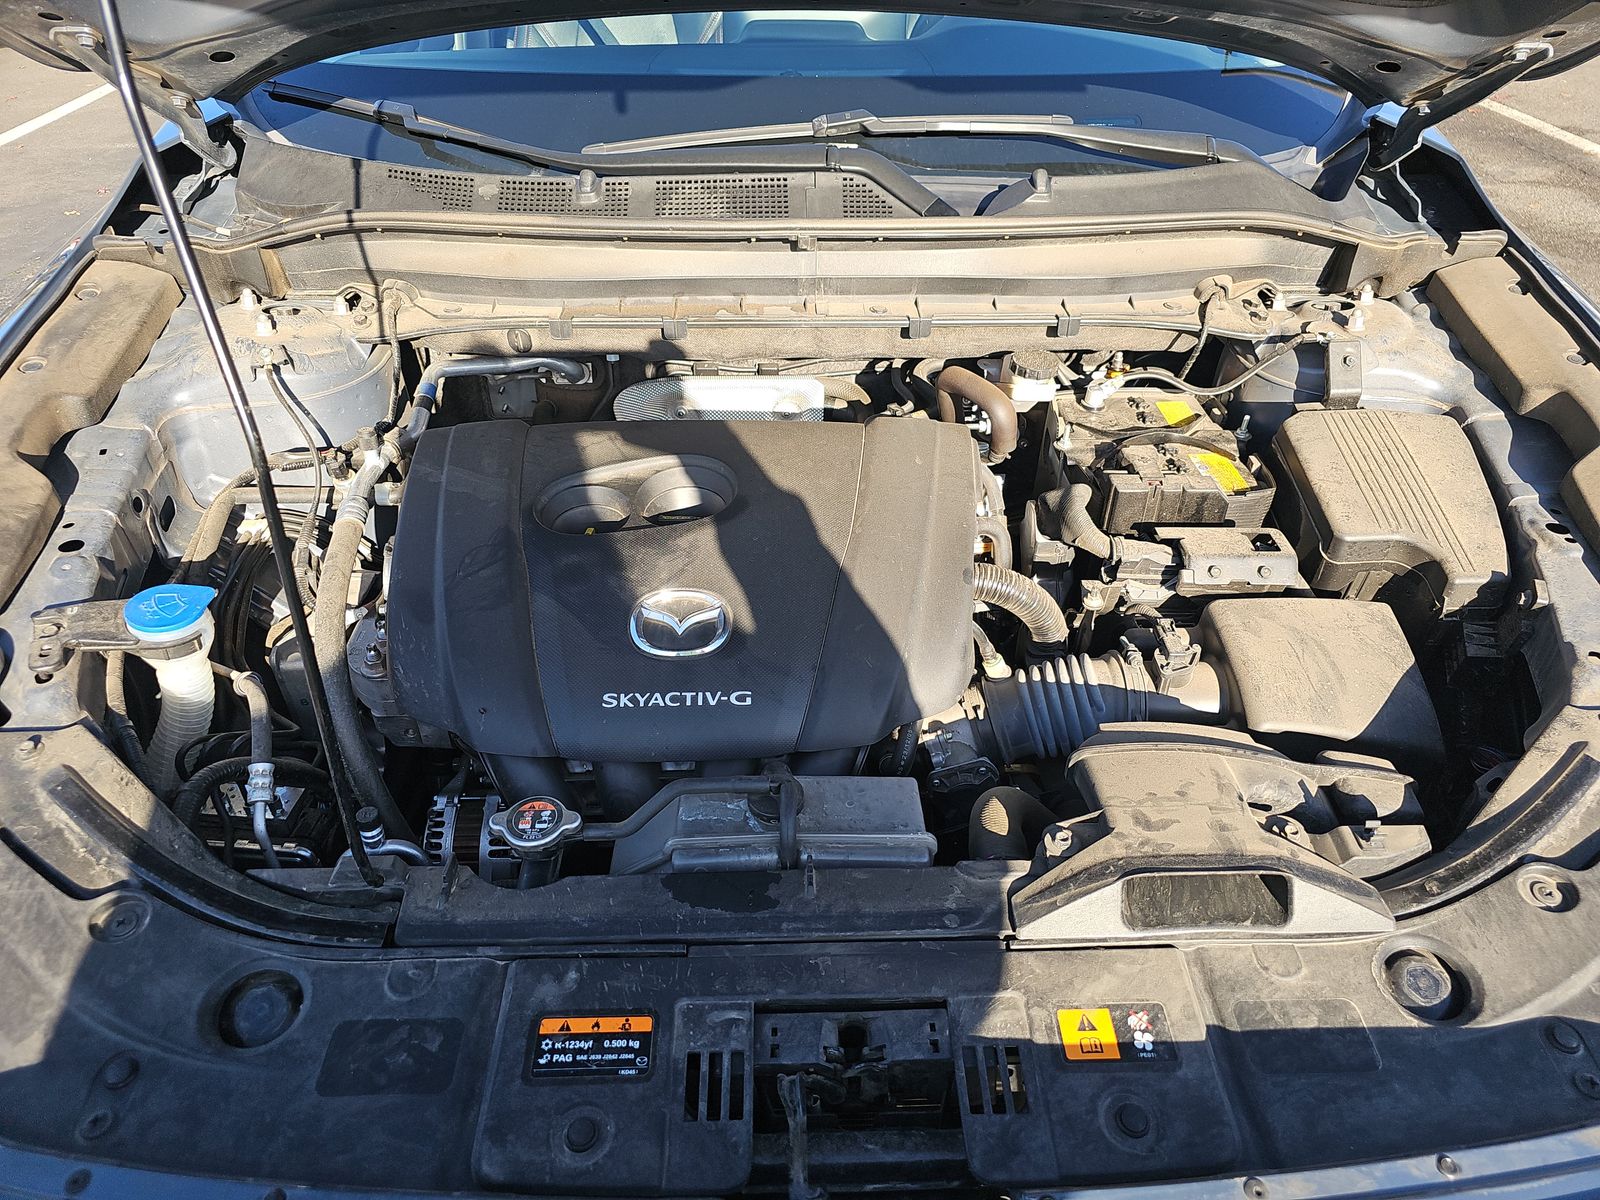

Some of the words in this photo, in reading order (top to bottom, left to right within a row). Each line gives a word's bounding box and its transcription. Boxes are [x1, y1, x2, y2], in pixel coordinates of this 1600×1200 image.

[602, 691, 752, 708] SKYACTIV-G
[603, 1039, 627, 1048] 0.500
[628, 1039, 640, 1049] kg
[552, 1053, 573, 1063] PAG
